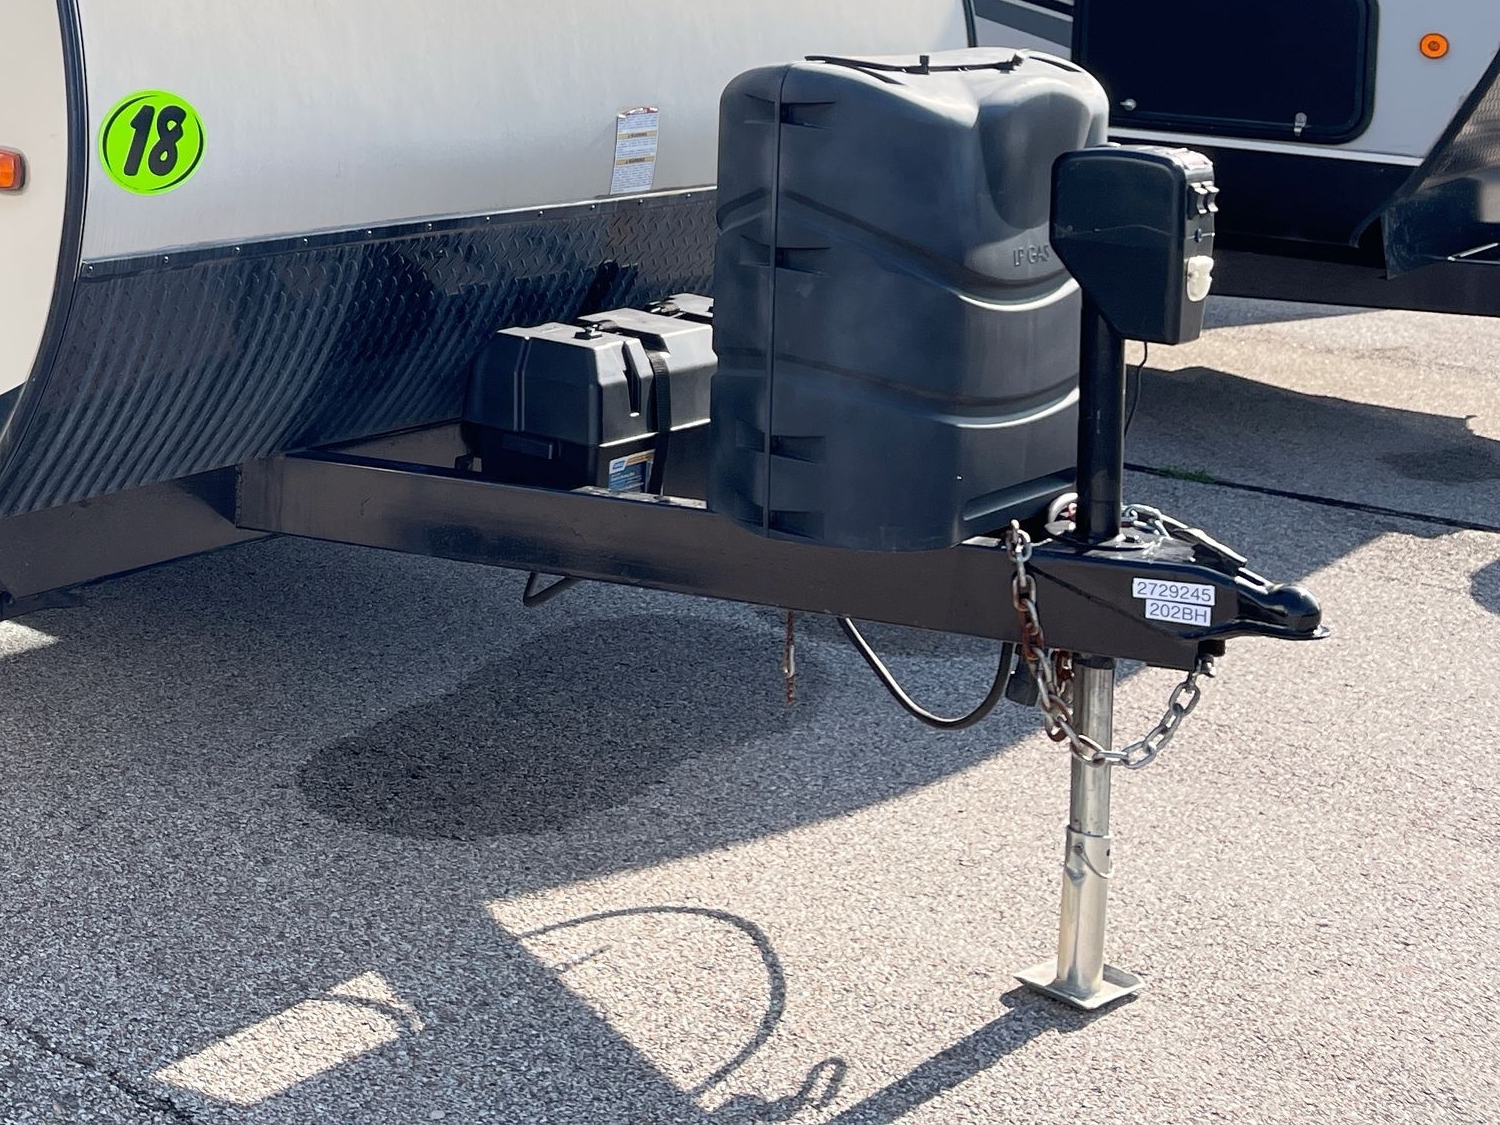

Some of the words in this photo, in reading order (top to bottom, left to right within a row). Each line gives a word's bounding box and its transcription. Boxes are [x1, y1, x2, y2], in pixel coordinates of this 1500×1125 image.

[123, 104, 187, 177] 18
[1026, 243, 1051, 265] GAS
[1137, 581, 1212, 602] 2729245
[1149, 602, 1207, 623] 202BH
